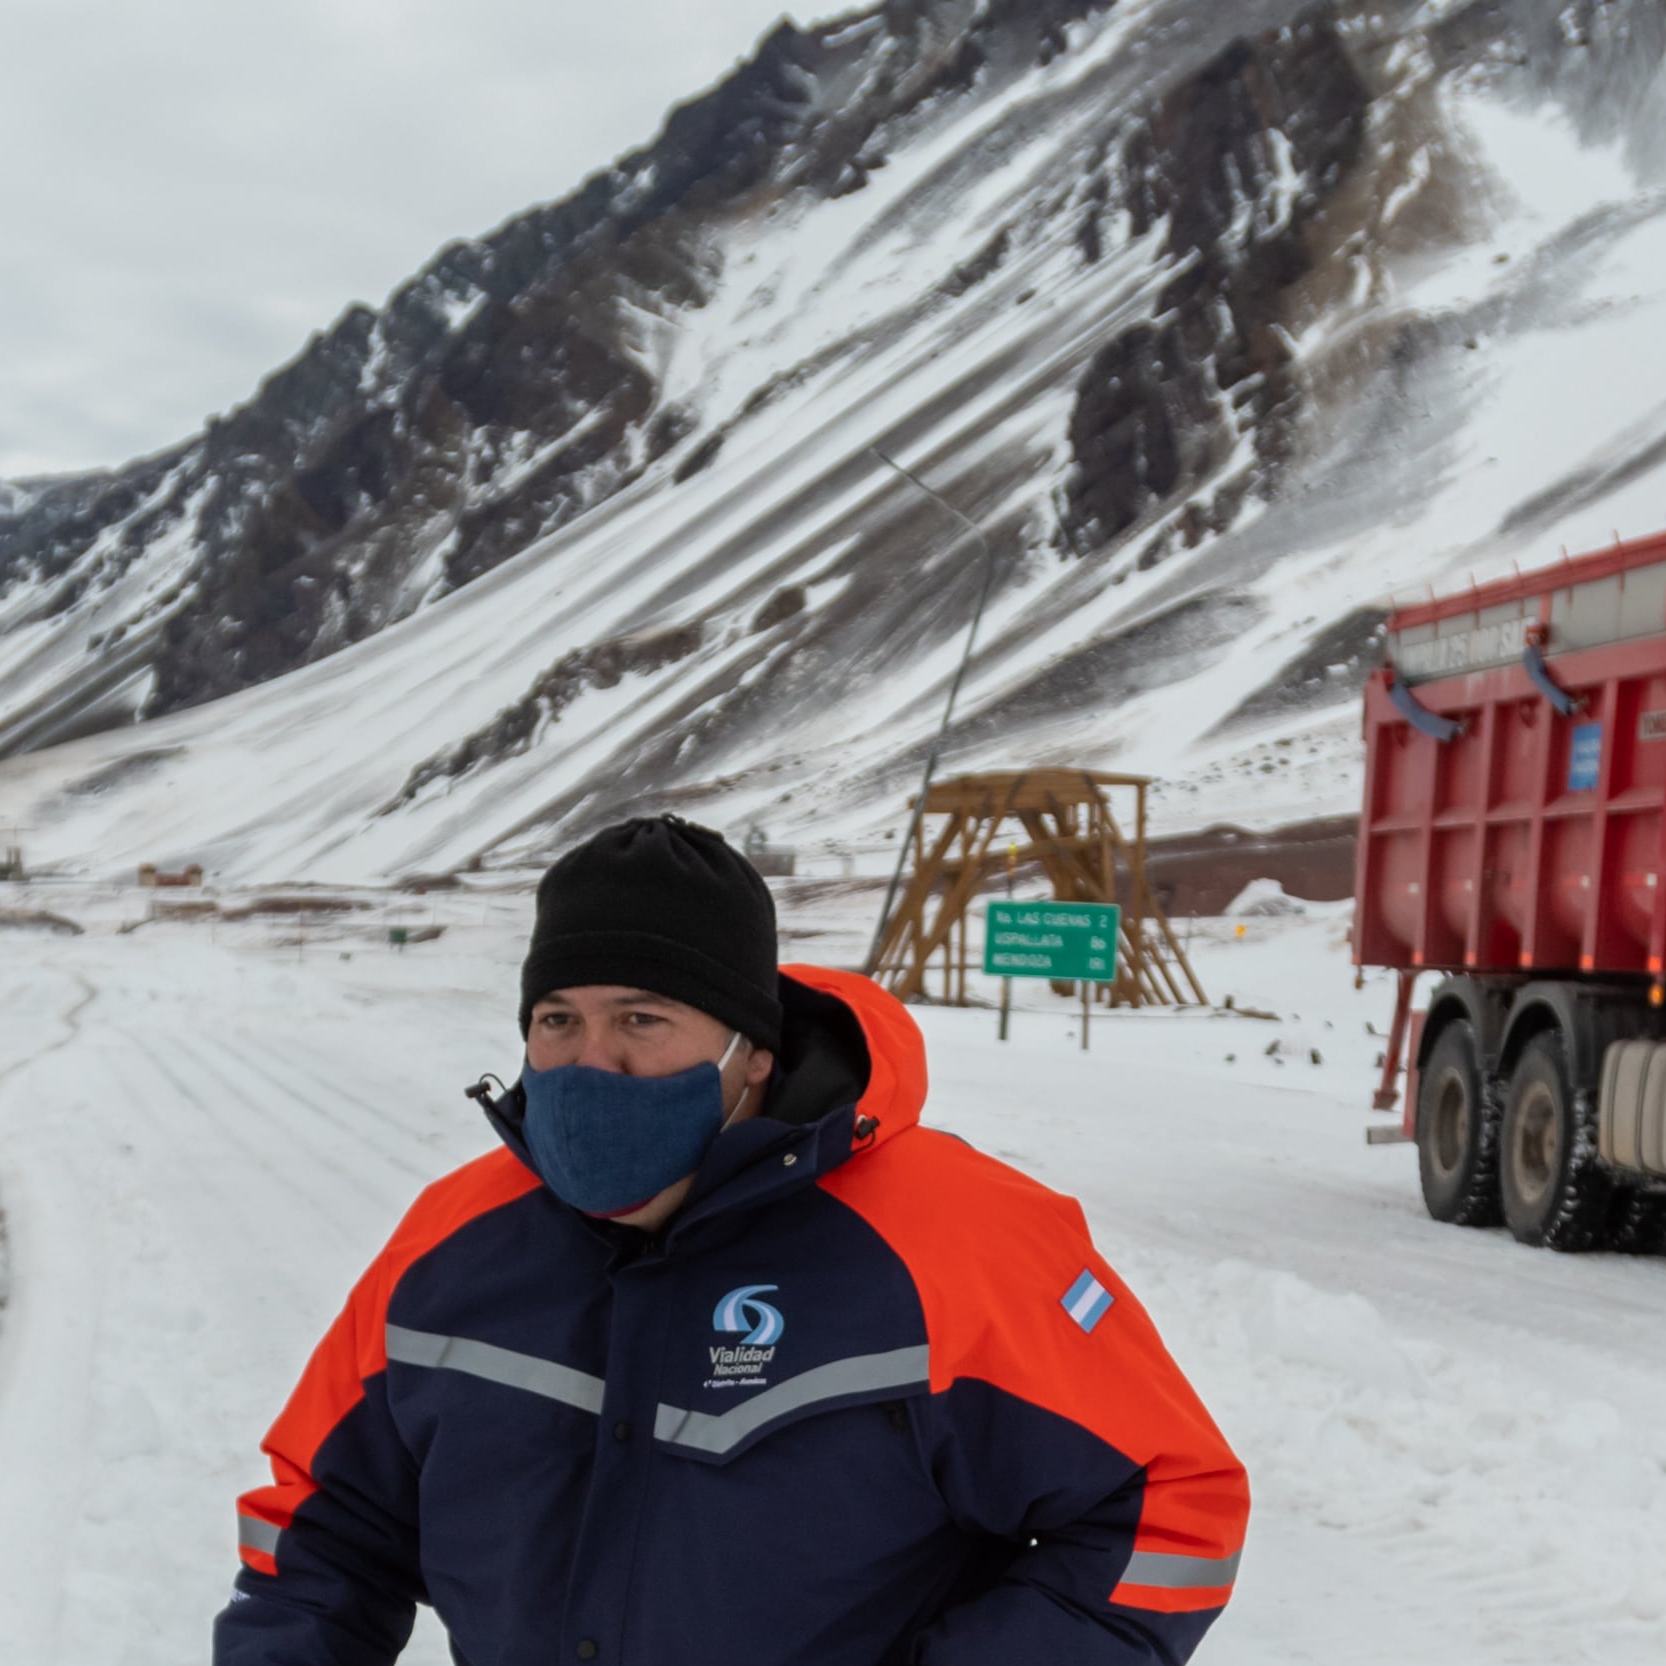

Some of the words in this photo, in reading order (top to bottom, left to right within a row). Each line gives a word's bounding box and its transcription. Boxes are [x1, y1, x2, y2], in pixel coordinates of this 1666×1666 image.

[1016, 911, 1040, 927] LAS
[1099, 914, 1108, 929] 2
[709, 1346, 776, 1364] Vialidad
[713, 1362, 763, 1376] Nacional
